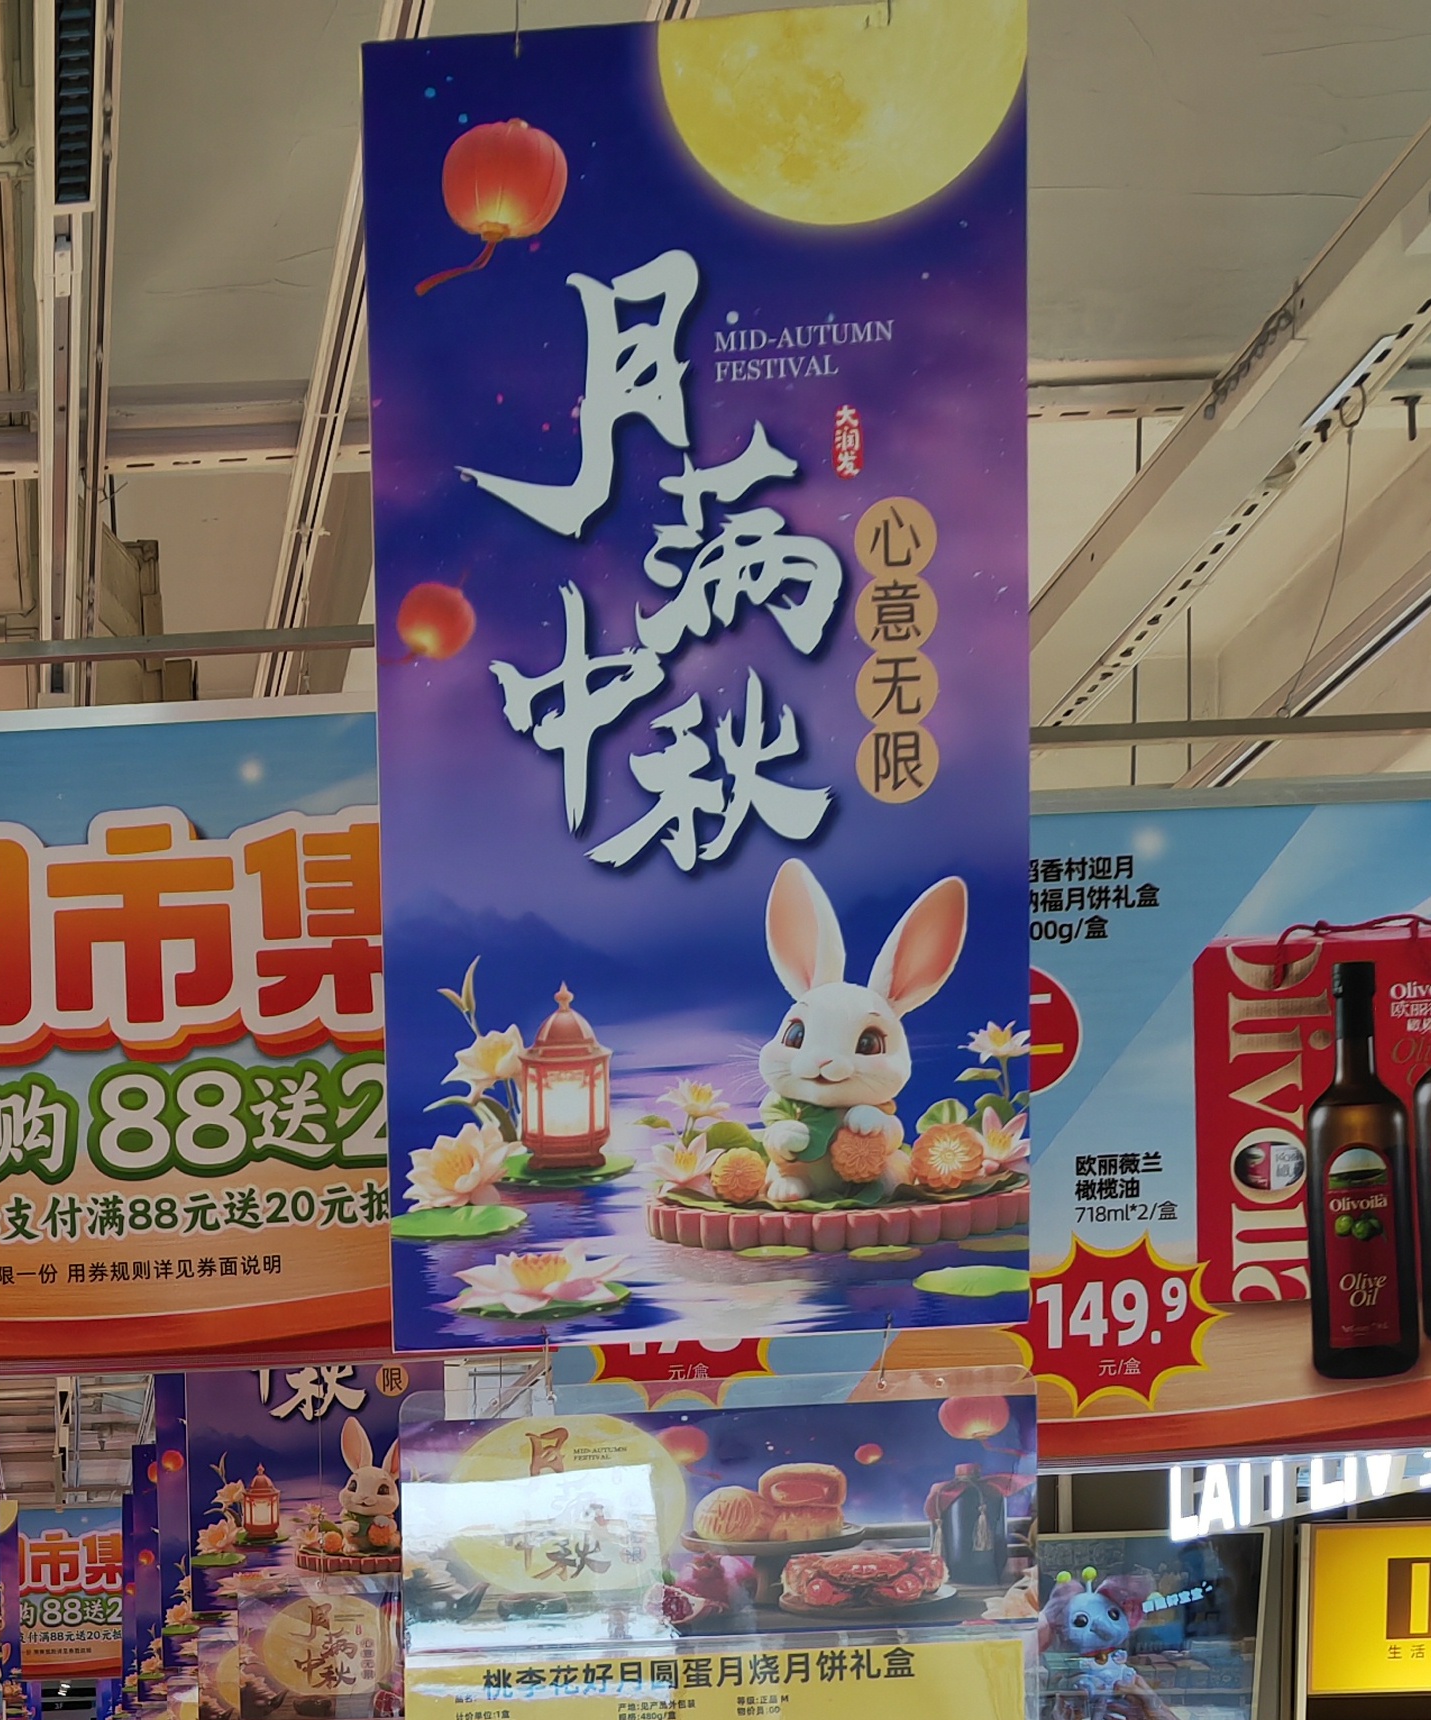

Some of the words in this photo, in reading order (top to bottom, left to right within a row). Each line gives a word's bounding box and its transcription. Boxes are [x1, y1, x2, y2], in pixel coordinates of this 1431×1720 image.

[714, 319, 895, 353] MID-AUTUMN
[714, 354, 839, 383] FESTIVAL
[835, 406, 861, 476] 大润发
[870, 505, 925, 793] 心意无限
[1075, 1153, 1163, 1177] 欧丽薇兰
[1075, 1177, 1140, 1202] 橄榄油
[67, 1255, 283, 1285] 用券规则详见券面说明
[1338, 1272, 1388, 1292] Olive
[1349, 1287, 1379, 1308] Oil
[1035, 1277, 1188, 1348] 149.9
[668, 1362, 710, 1381] 元/盒
[1098, 1358, 1142, 1377] 元/盒
[18, 1534, 123, 1586] 市集
[482, 1646, 916, 1701] 桃李花好月圆蛋月烧月饼礼盒
